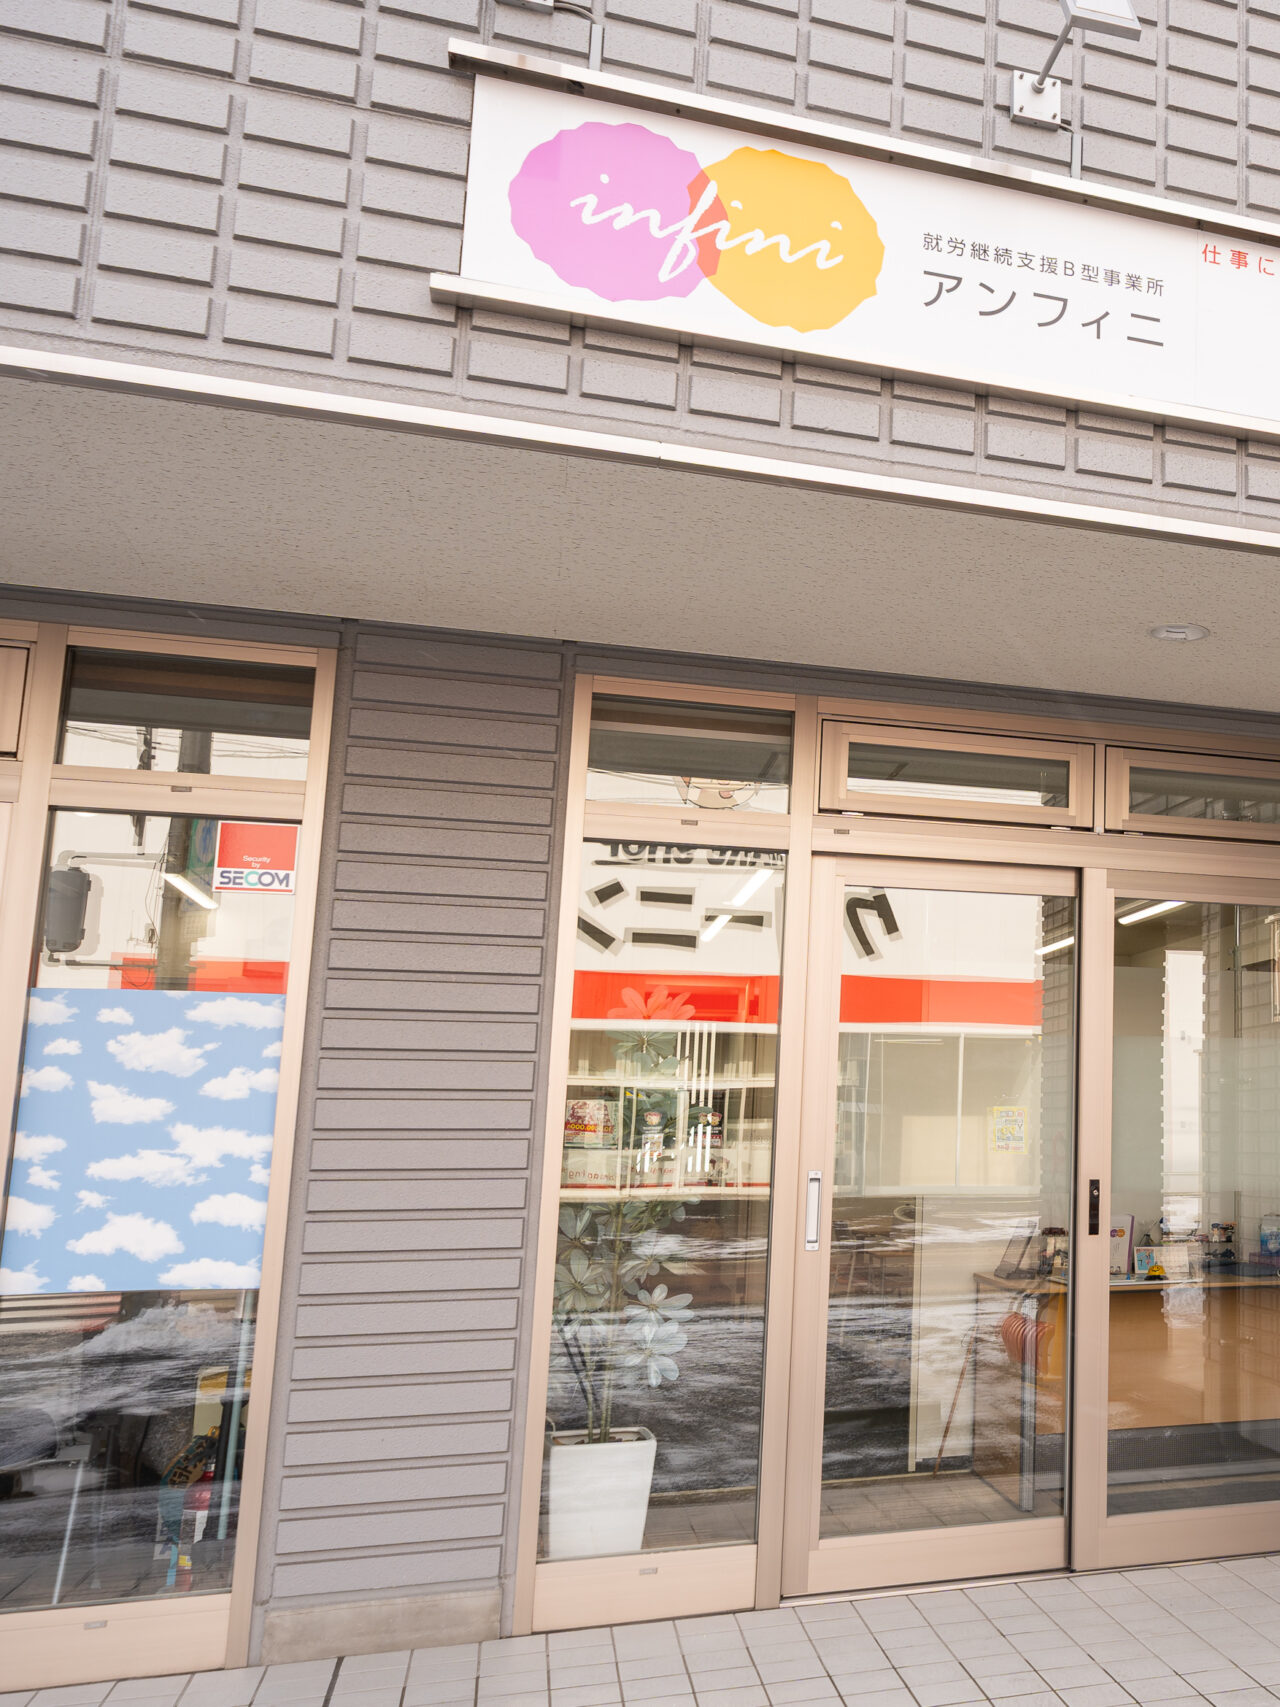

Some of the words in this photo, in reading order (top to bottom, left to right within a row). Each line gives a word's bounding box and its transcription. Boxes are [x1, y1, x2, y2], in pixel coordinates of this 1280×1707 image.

[570, 174, 844, 283] infini
[923, 232, 1165, 298] 就労継続支援B型事業所
[923, 270, 1164, 347] アンフィニ
[220, 870, 290, 888] SECOM
[243, 855, 271, 863] Security
